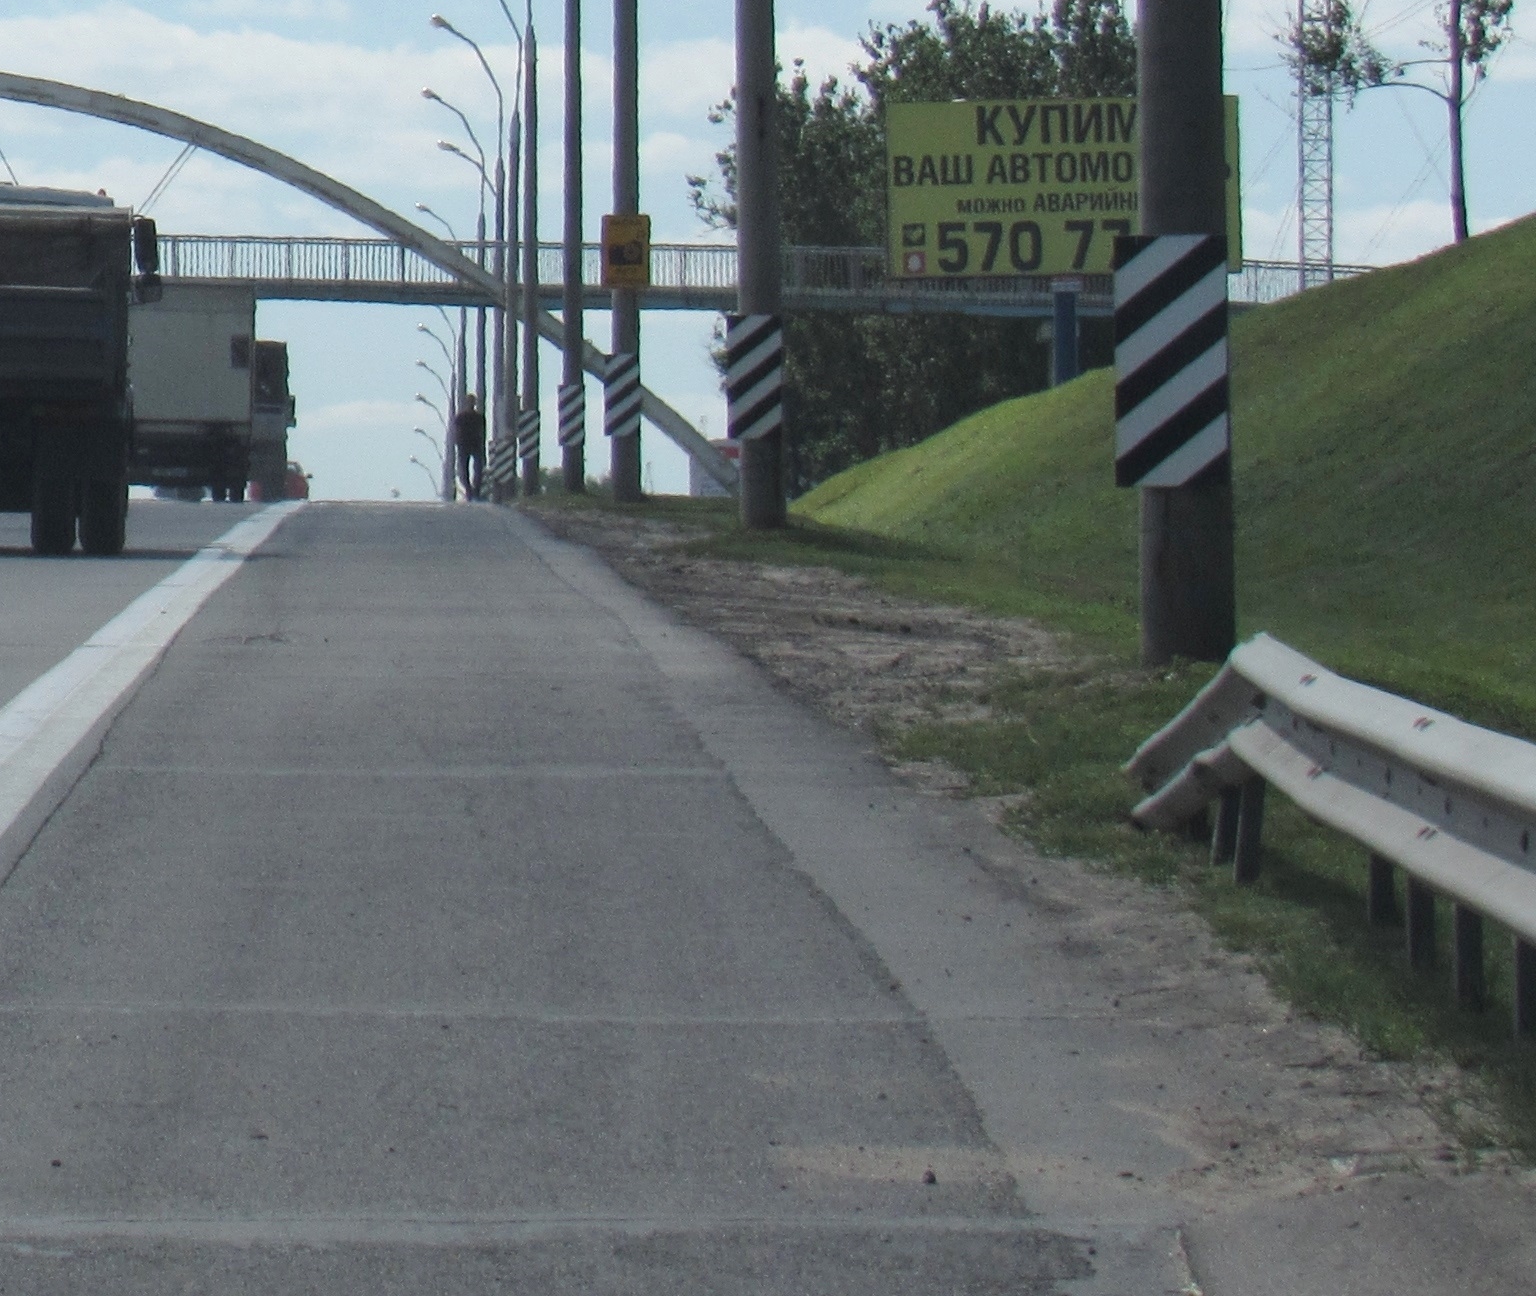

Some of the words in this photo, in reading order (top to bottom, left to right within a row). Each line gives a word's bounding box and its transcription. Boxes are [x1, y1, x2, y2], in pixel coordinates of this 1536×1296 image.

[893, 154, 973, 187] ВАШ
[986, 151, 1134, 185] АВТОМО
[1033, 186, 1138, 213] АВАРИЙН
[937, 220, 1043, 273] 570
